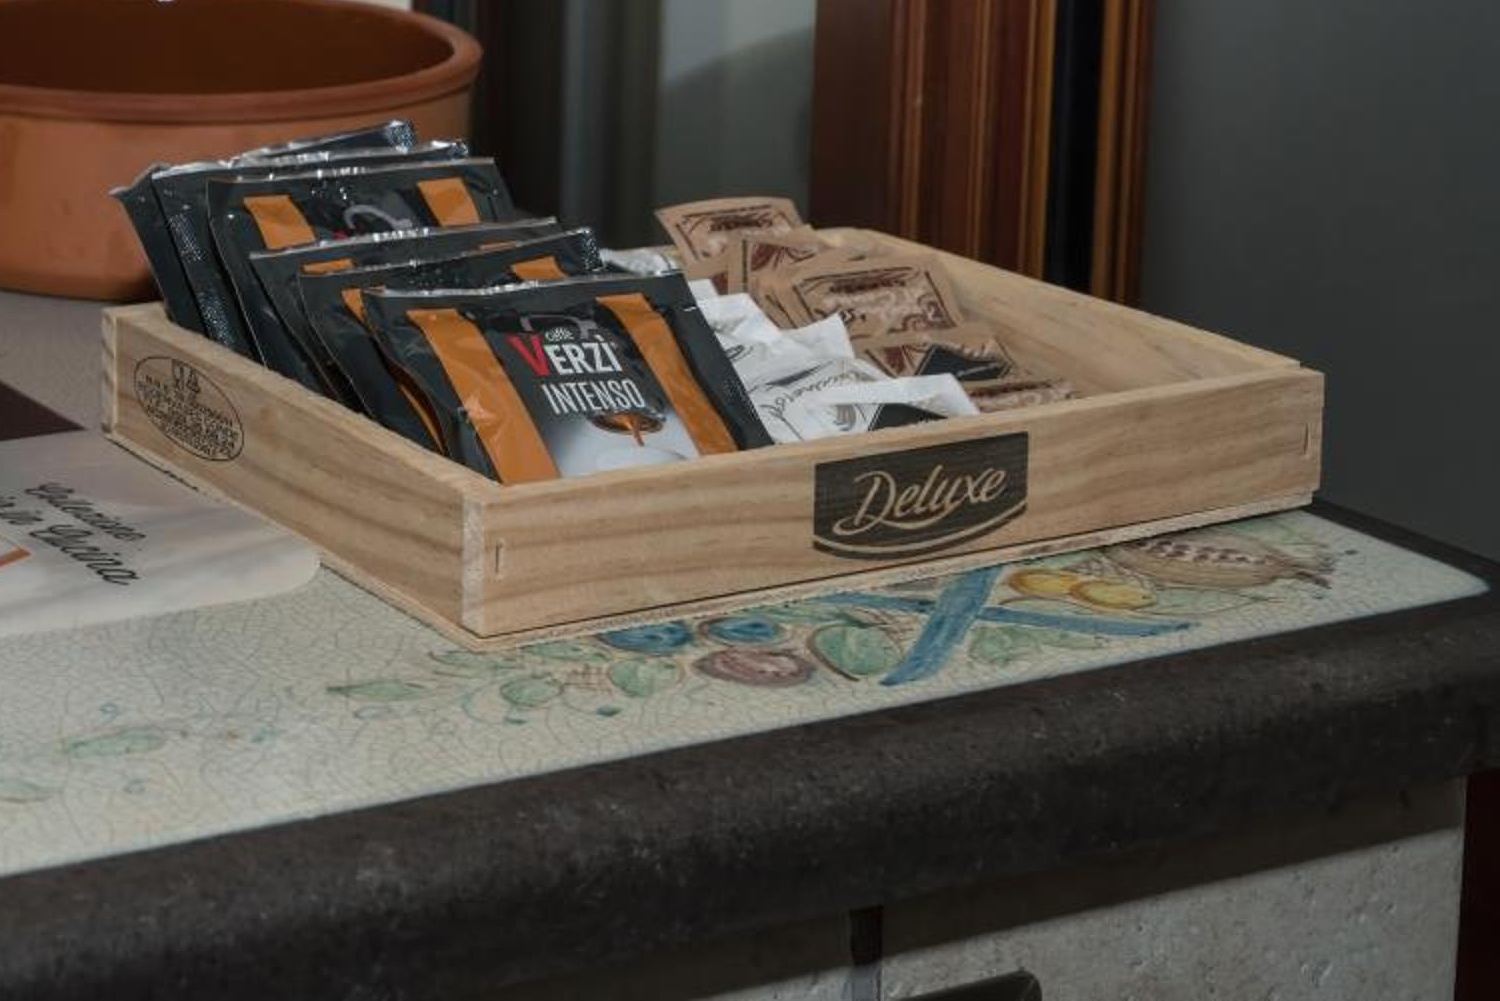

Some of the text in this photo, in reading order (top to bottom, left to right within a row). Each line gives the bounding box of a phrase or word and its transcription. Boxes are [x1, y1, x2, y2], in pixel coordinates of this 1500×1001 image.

[505, 333, 622, 376] VERZÌ
[541, 378, 646, 415] INTENSO
[832, 464, 1006, 536] Deluxe
[29, 524, 141, 586] Cucina
